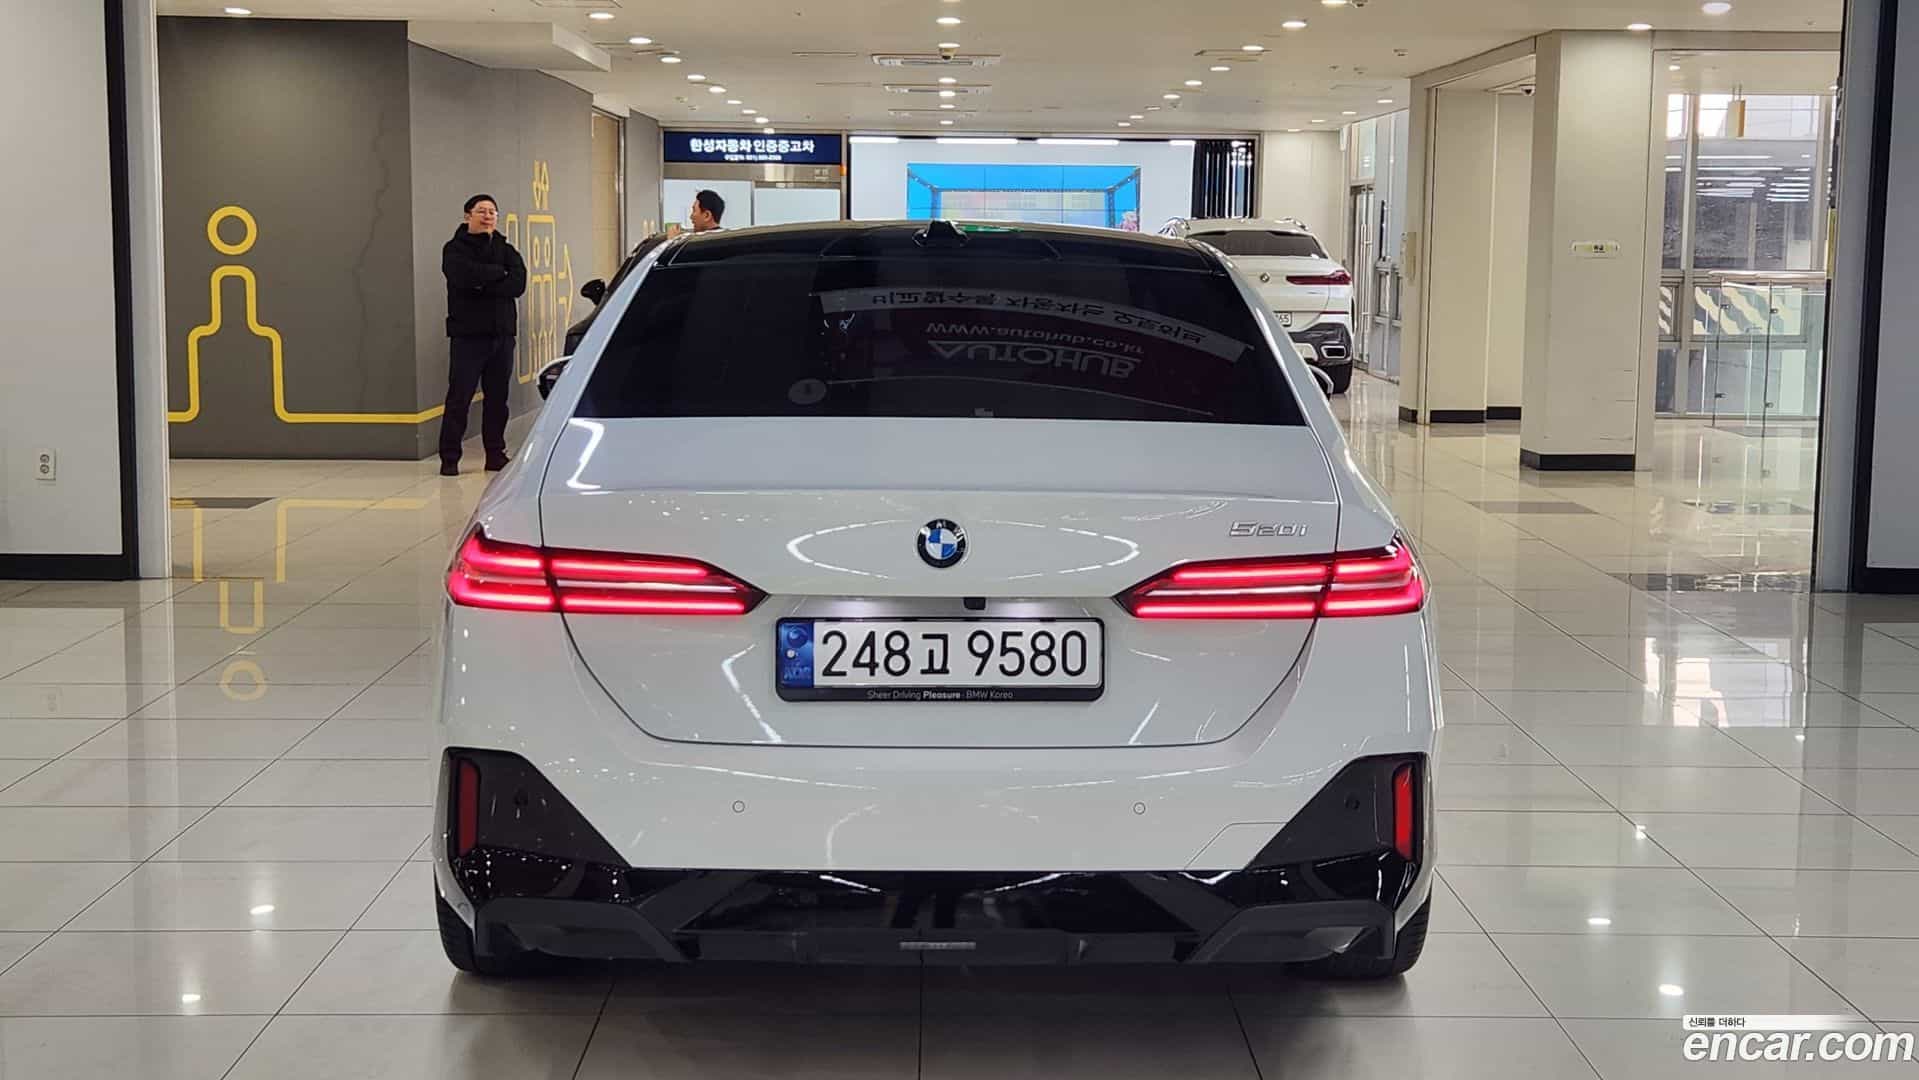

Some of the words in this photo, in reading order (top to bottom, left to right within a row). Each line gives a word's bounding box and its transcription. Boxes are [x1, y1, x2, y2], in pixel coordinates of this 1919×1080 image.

[689, 138, 752, 153] 한성자동차
[753, 139, 815, 153] 인증중고차
[1229, 520, 1308, 537] 520i
[821, 629, 950, 677] 248고
[966, 629, 1088, 677] 9580
[866, 689, 891, 700] Sheer
[892, 689, 921, 701] Driving
[922, 689, 961, 699] Pleasure
[966, 689, 989, 699] BMW
[989, 689, 1014, 699] Korea
